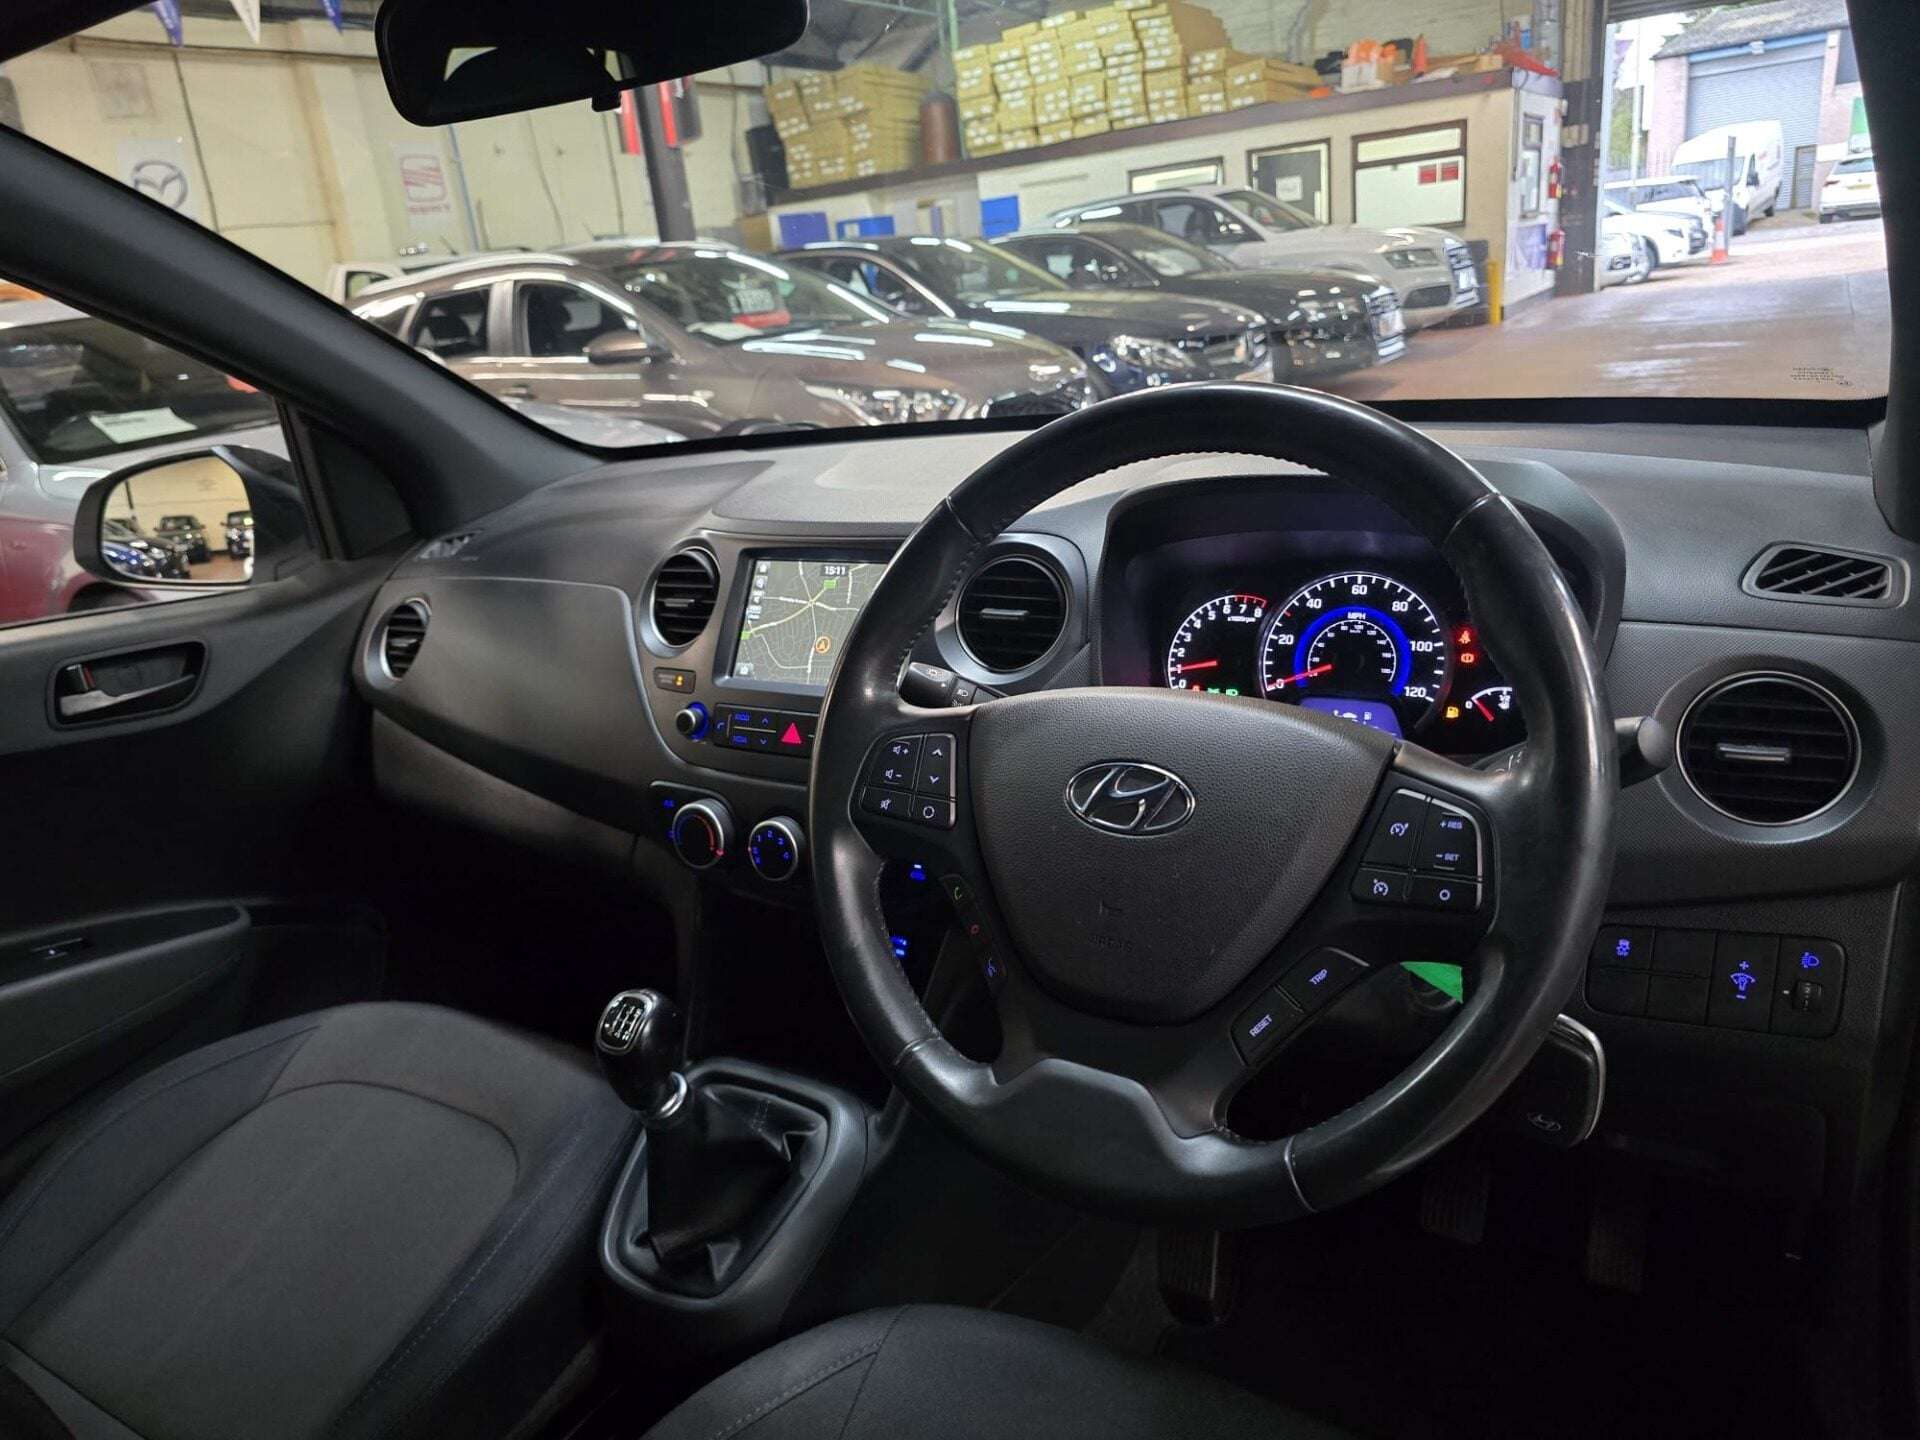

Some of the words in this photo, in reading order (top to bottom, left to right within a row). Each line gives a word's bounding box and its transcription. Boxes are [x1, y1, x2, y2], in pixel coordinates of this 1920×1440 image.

[824, 566, 846, 575] 15:11
[1351, 585, 1367, 595] 60
[1223, 604, 1231, 614] 6
[1239, 604, 1247, 614] 7
[1306, 599, 1322, 609] 40
[1392, 601, 1408, 612] 80
[1208, 610, 1216, 620] 5
[1254, 607, 1262, 618] 8
[1347, 612, 1366, 620] MPH
[1193, 619, 1201, 629] 4
[1184, 632, 1191, 642] 3
[1278, 634, 1294, 645] 20
[1410, 640, 1433, 652] 100
[1177, 648, 1185, 657] 2
[1179, 680, 1186, 689] 0
[1275, 679, 1284, 689] 0
[1404, 686, 1426, 698] 120
[1465, 700, 1473, 709] 0
[1309, 968, 1328, 986] TRIP
[1249, 1014, 1273, 1037] RESET
